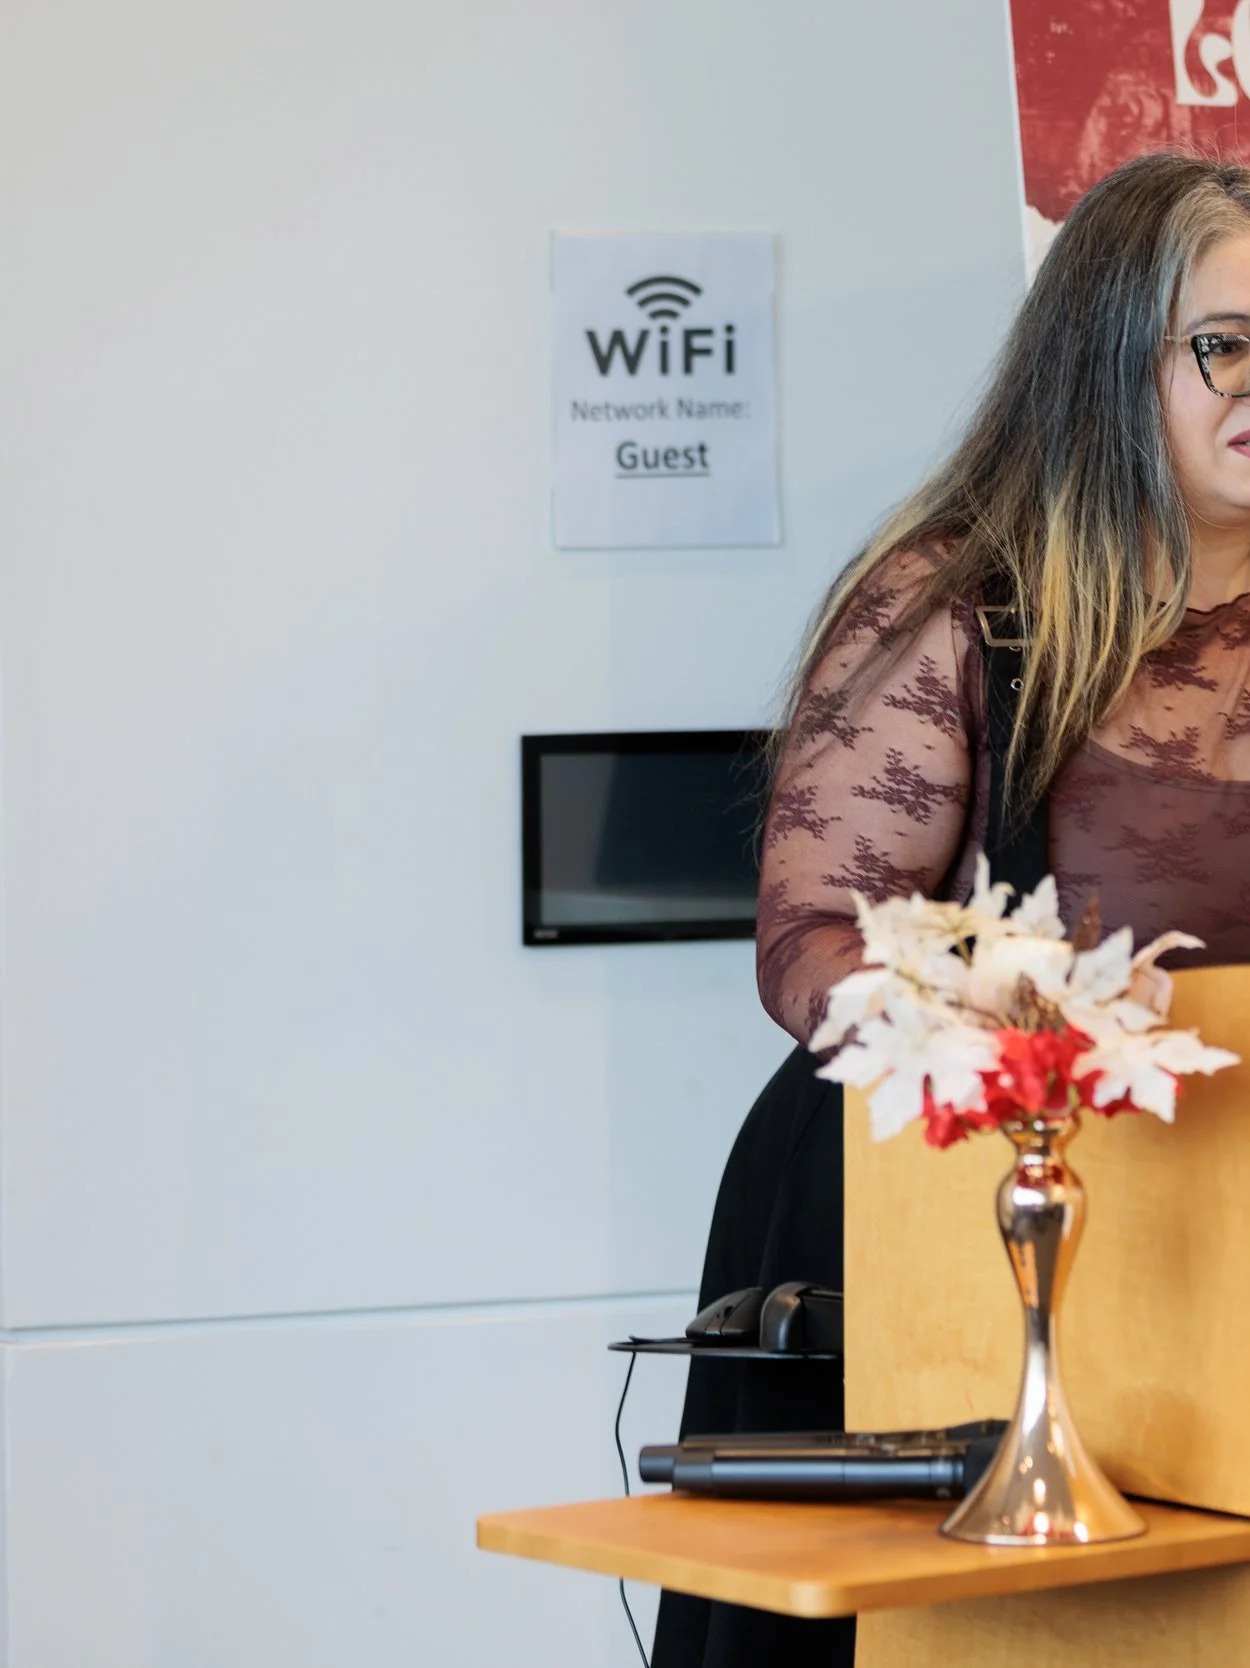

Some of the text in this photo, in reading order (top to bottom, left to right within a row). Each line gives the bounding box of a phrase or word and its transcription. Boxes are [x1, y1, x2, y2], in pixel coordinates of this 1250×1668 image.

[585, 324, 736, 378] WiFi
[571, 398, 752, 422] Network Name:
[615, 441, 711, 471] Guest
